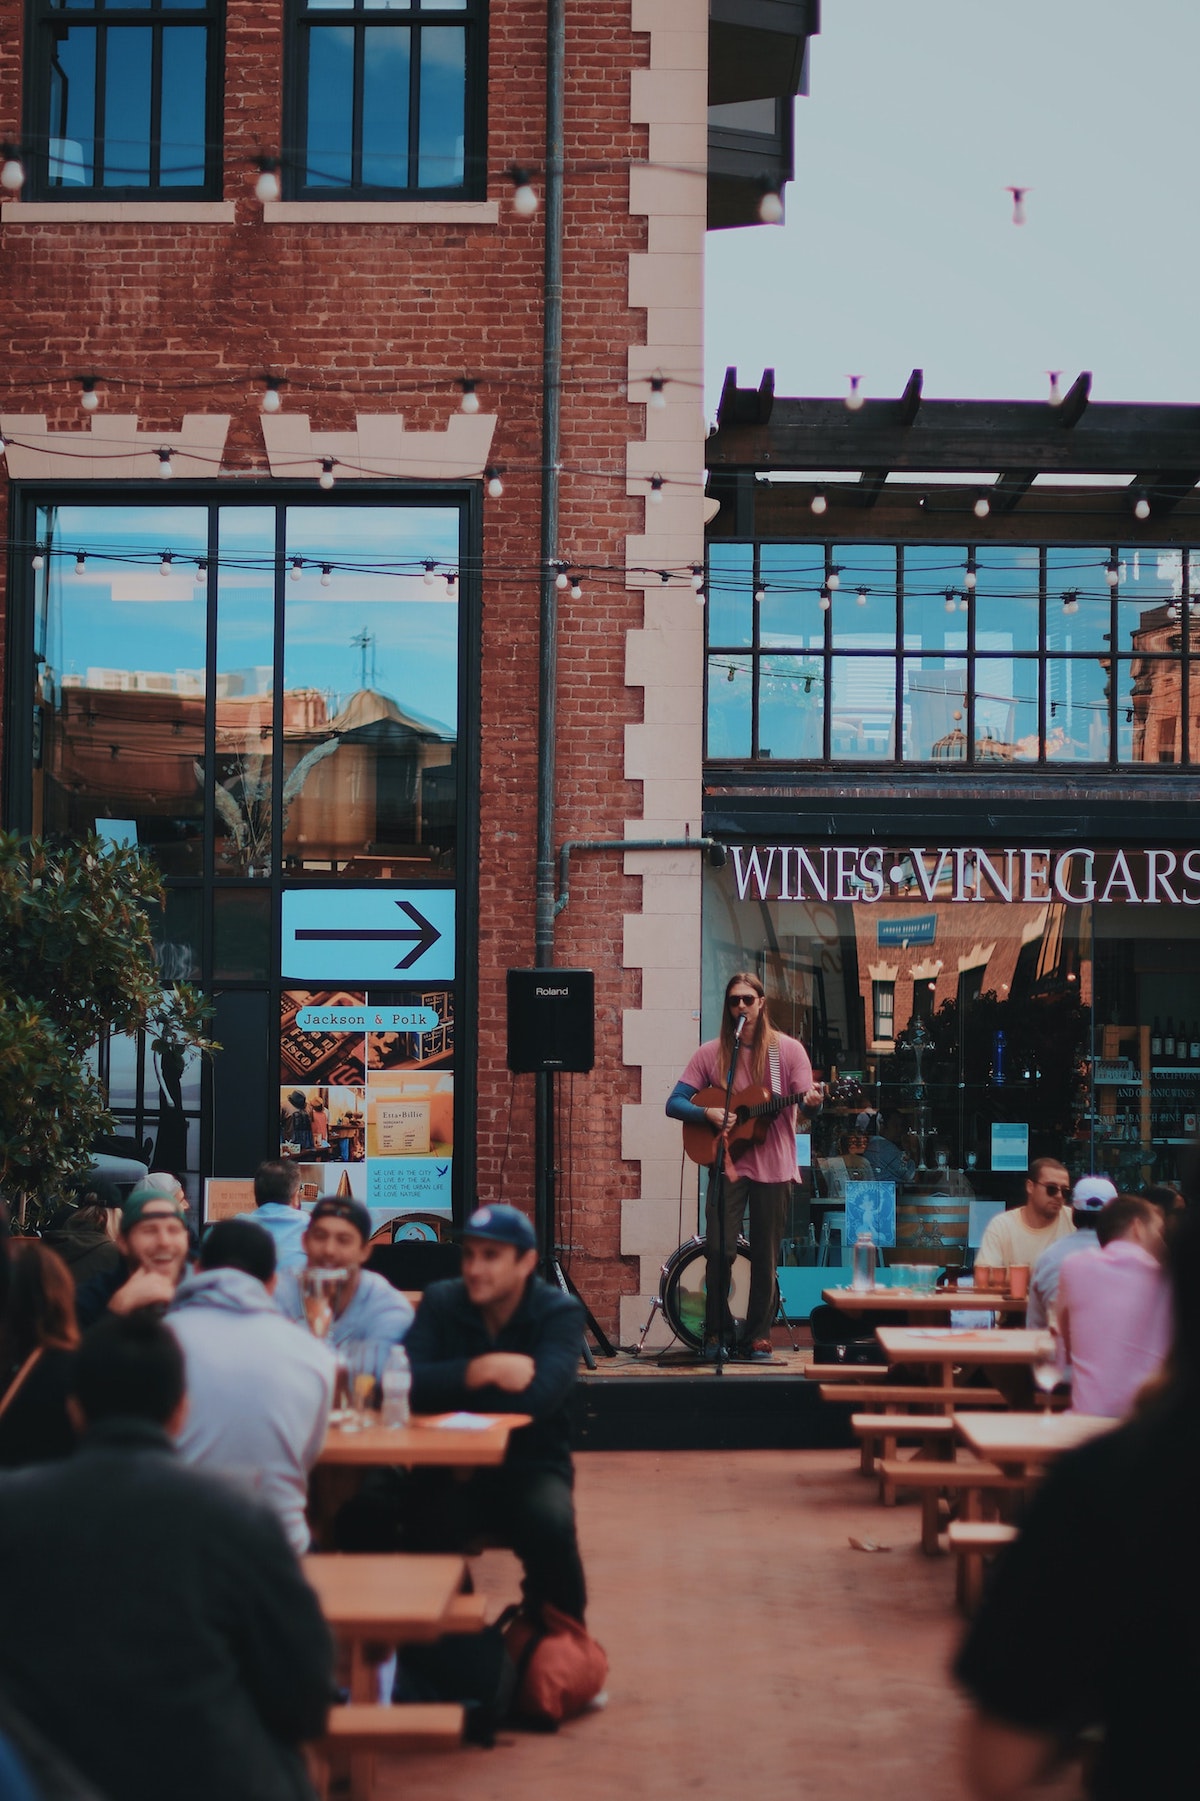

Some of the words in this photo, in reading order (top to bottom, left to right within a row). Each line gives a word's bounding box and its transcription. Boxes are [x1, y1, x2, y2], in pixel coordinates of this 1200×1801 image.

[729, 846, 884, 902] WINES
[910, 847, 1200, 905] VINEGARS
[535, 987, 569, 996] Roland
[303, 1013, 365, 1025] Jackson
[375, 1014, 383, 1025] &
[392, 1013, 427, 1025] Polk
[1117, 1088, 1134, 1097] AND
[1135, 1088, 1170, 1098] ORGANIC
[1171, 1088, 1195, 1098] WINES
